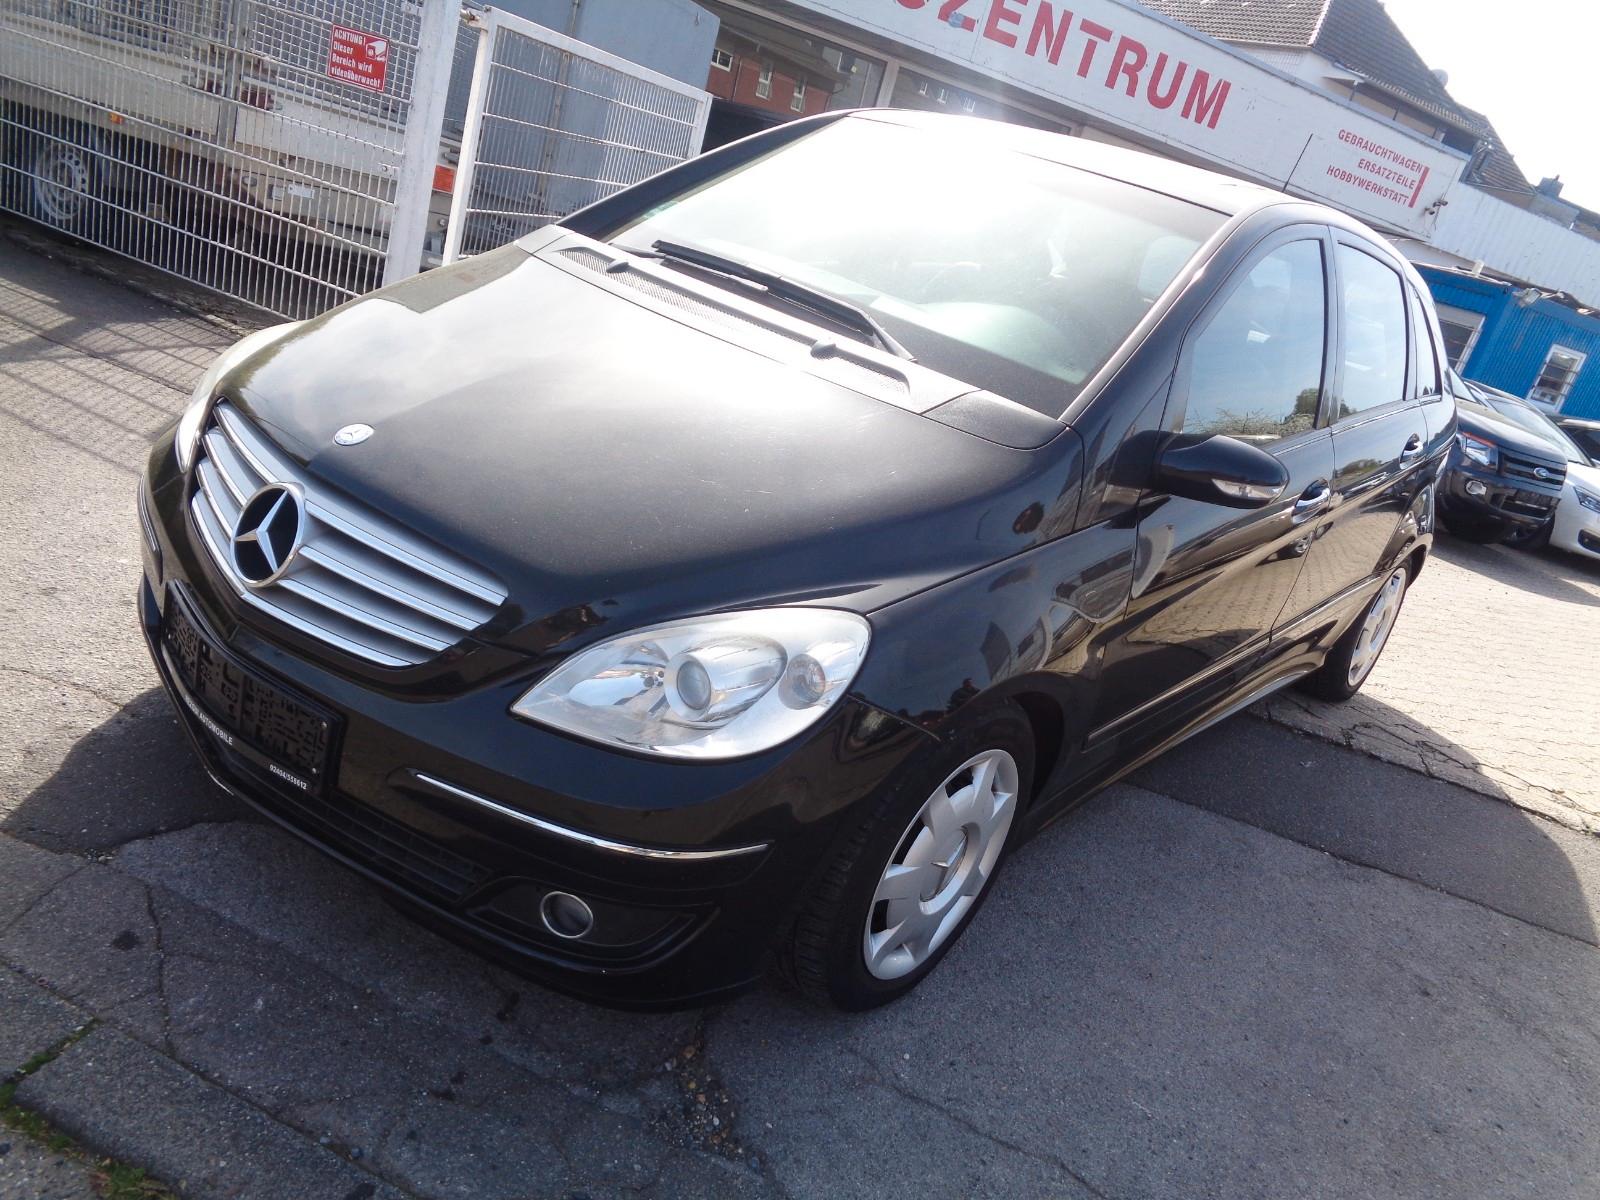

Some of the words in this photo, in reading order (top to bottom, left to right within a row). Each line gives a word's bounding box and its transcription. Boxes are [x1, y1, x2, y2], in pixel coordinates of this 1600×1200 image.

[332, 52, 356, 68] Bereich
[357, 61, 373, 73] wird
[333, 40, 354, 55] Dieser
[896, 0, 1232, 130] ZENTRUM
[1337, 128, 1423, 174] GEBRAUCHTWAGEN
[1325, 164, 1410, 206] HOBBYWERKSTATT
[1357, 157, 1417, 191] ERSATZTEILE
